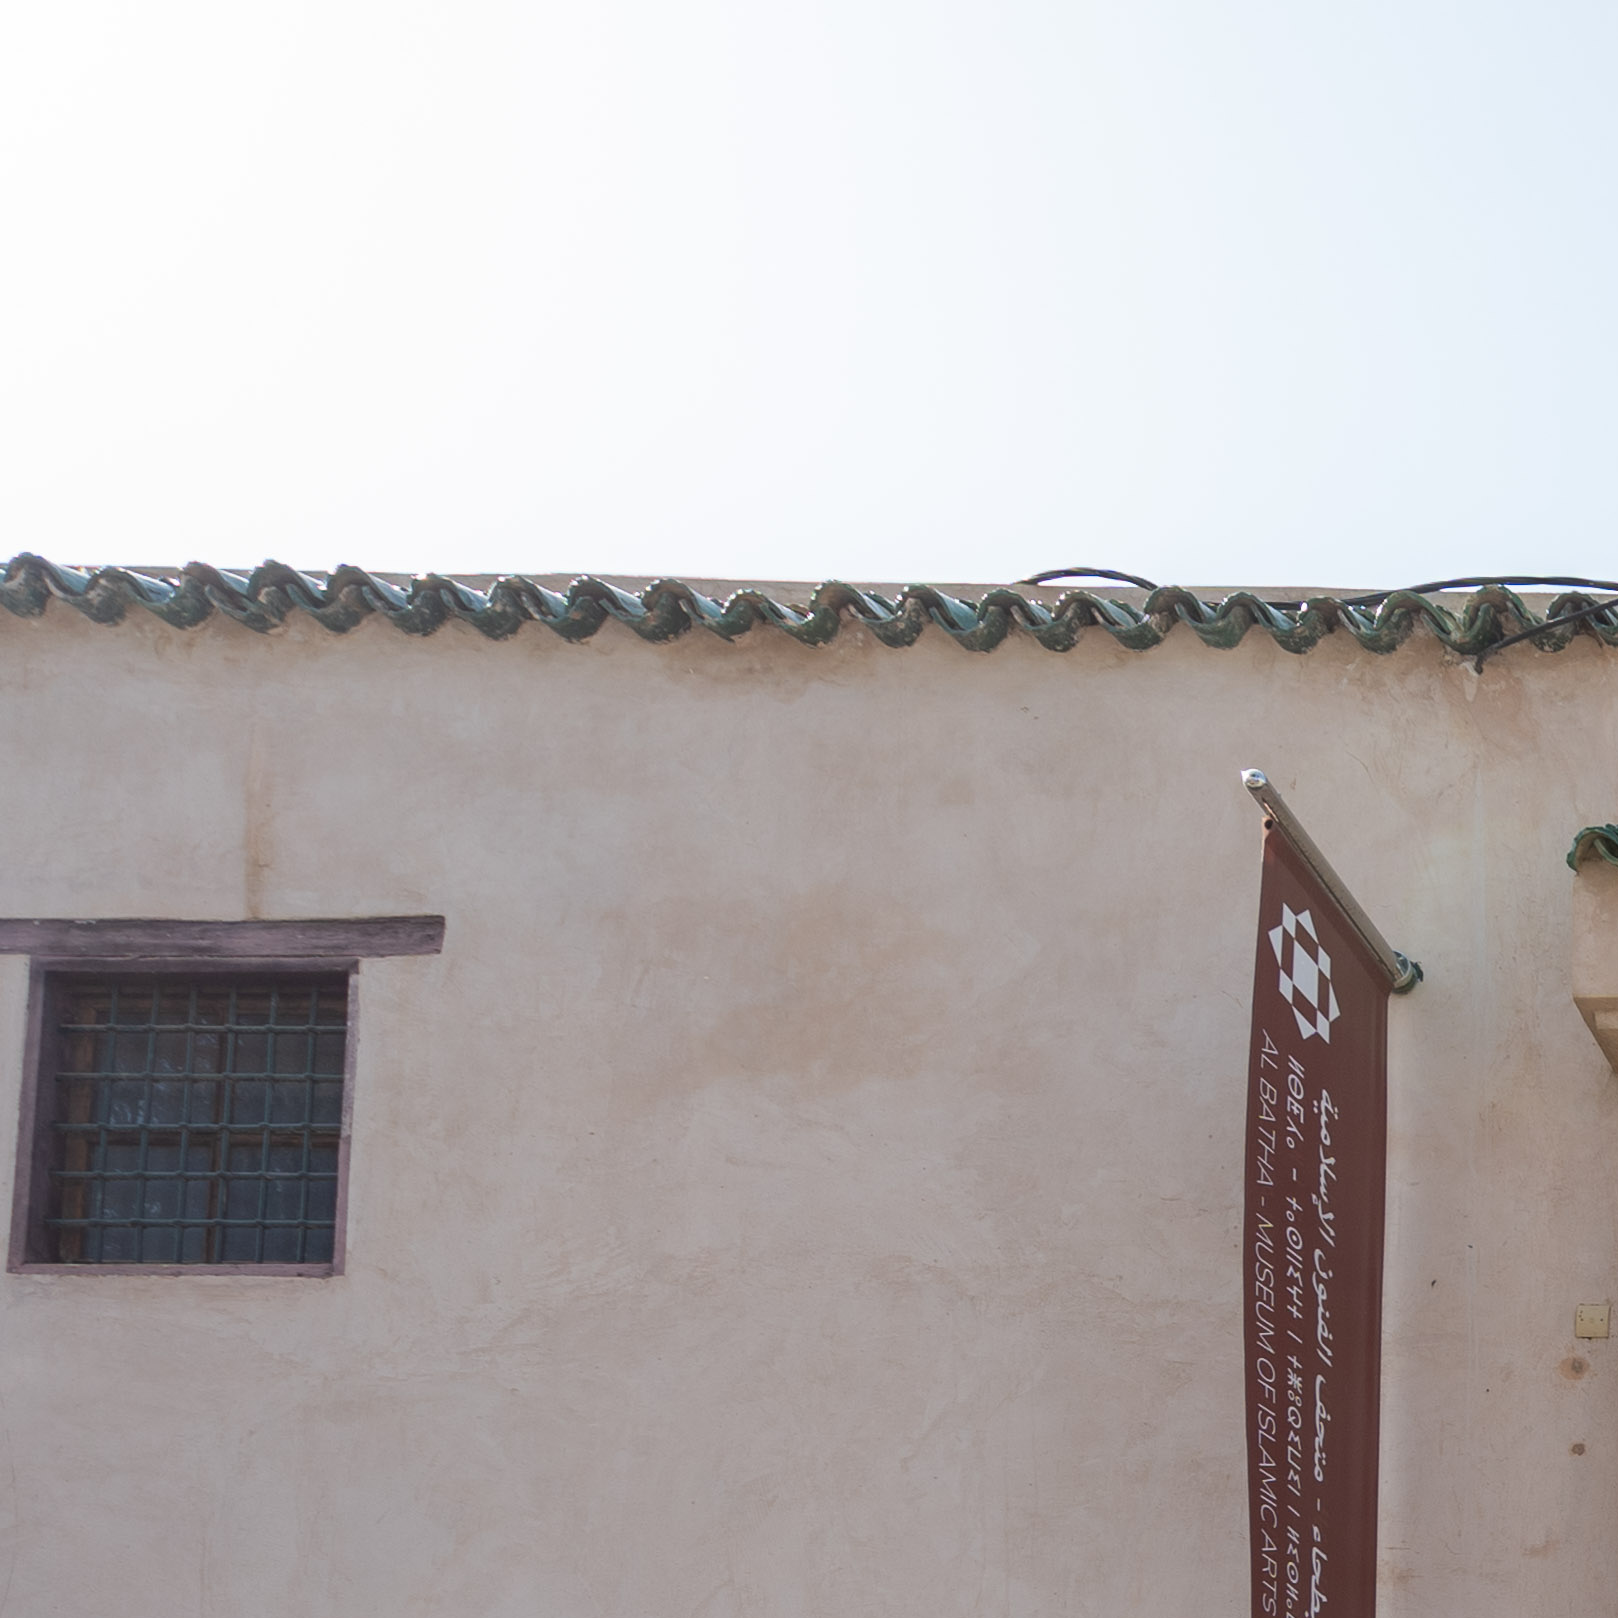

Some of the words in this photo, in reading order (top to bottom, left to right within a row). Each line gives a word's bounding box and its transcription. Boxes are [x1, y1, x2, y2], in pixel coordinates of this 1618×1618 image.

[1261, 1028, 1280, 1069] AL
[1256, 1076, 1278, 1187] BATHA
[1310, 1089, 1339, 1247] الإسلامية
[1254, 1212, 1276, 1354] MUSEUM
[1312, 1248, 1336, 1368] الفنون
[1256, 1357, 1276, 1404] OF
[1312, 1374, 1333, 1483] متحف
[1257, 1404, 1278, 1530] ISLAMIC
[1260, 1528, 1278, 1618] ARTS
